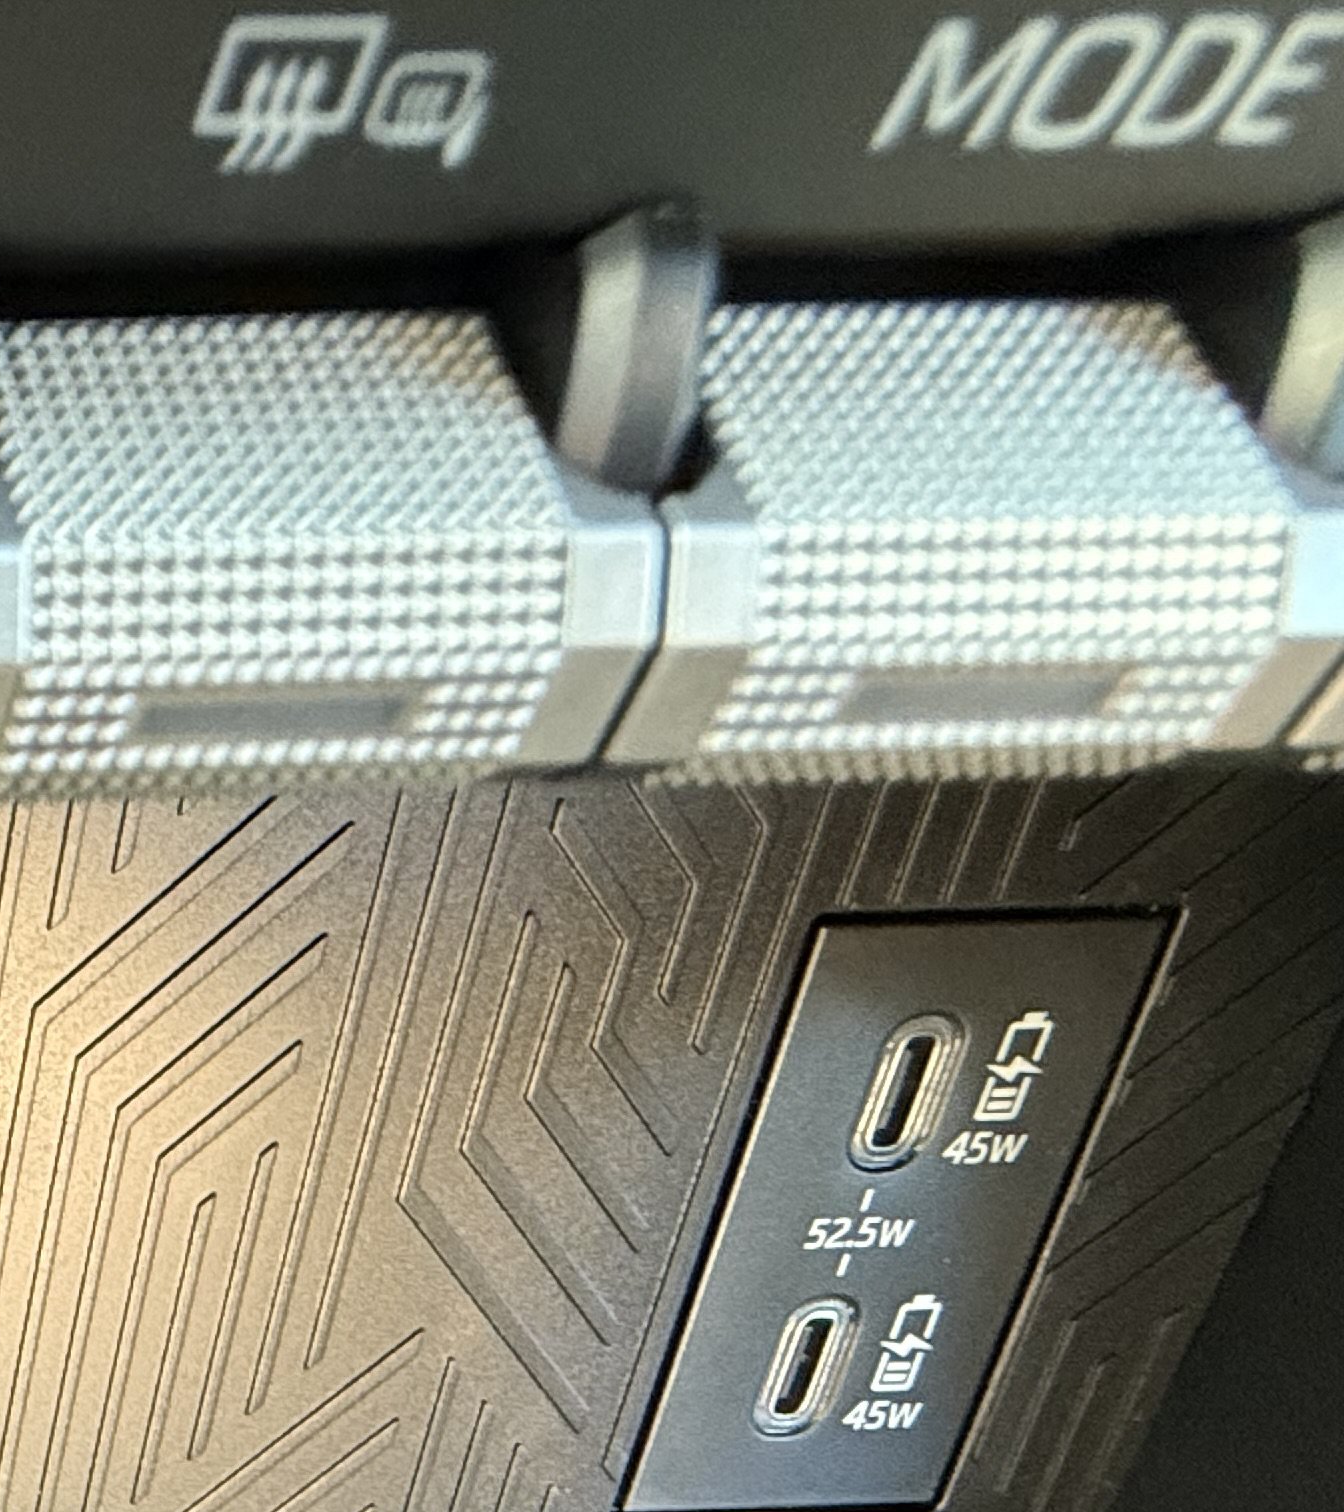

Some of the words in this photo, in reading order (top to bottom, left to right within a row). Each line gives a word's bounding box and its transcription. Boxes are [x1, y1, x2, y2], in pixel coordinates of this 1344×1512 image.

[867, 11, 1344, 153] MODE
[941, 1130, 1029, 1165] 45W
[802, 1216, 916, 1250] 52.5W
[841, 1399, 925, 1431] 45W
